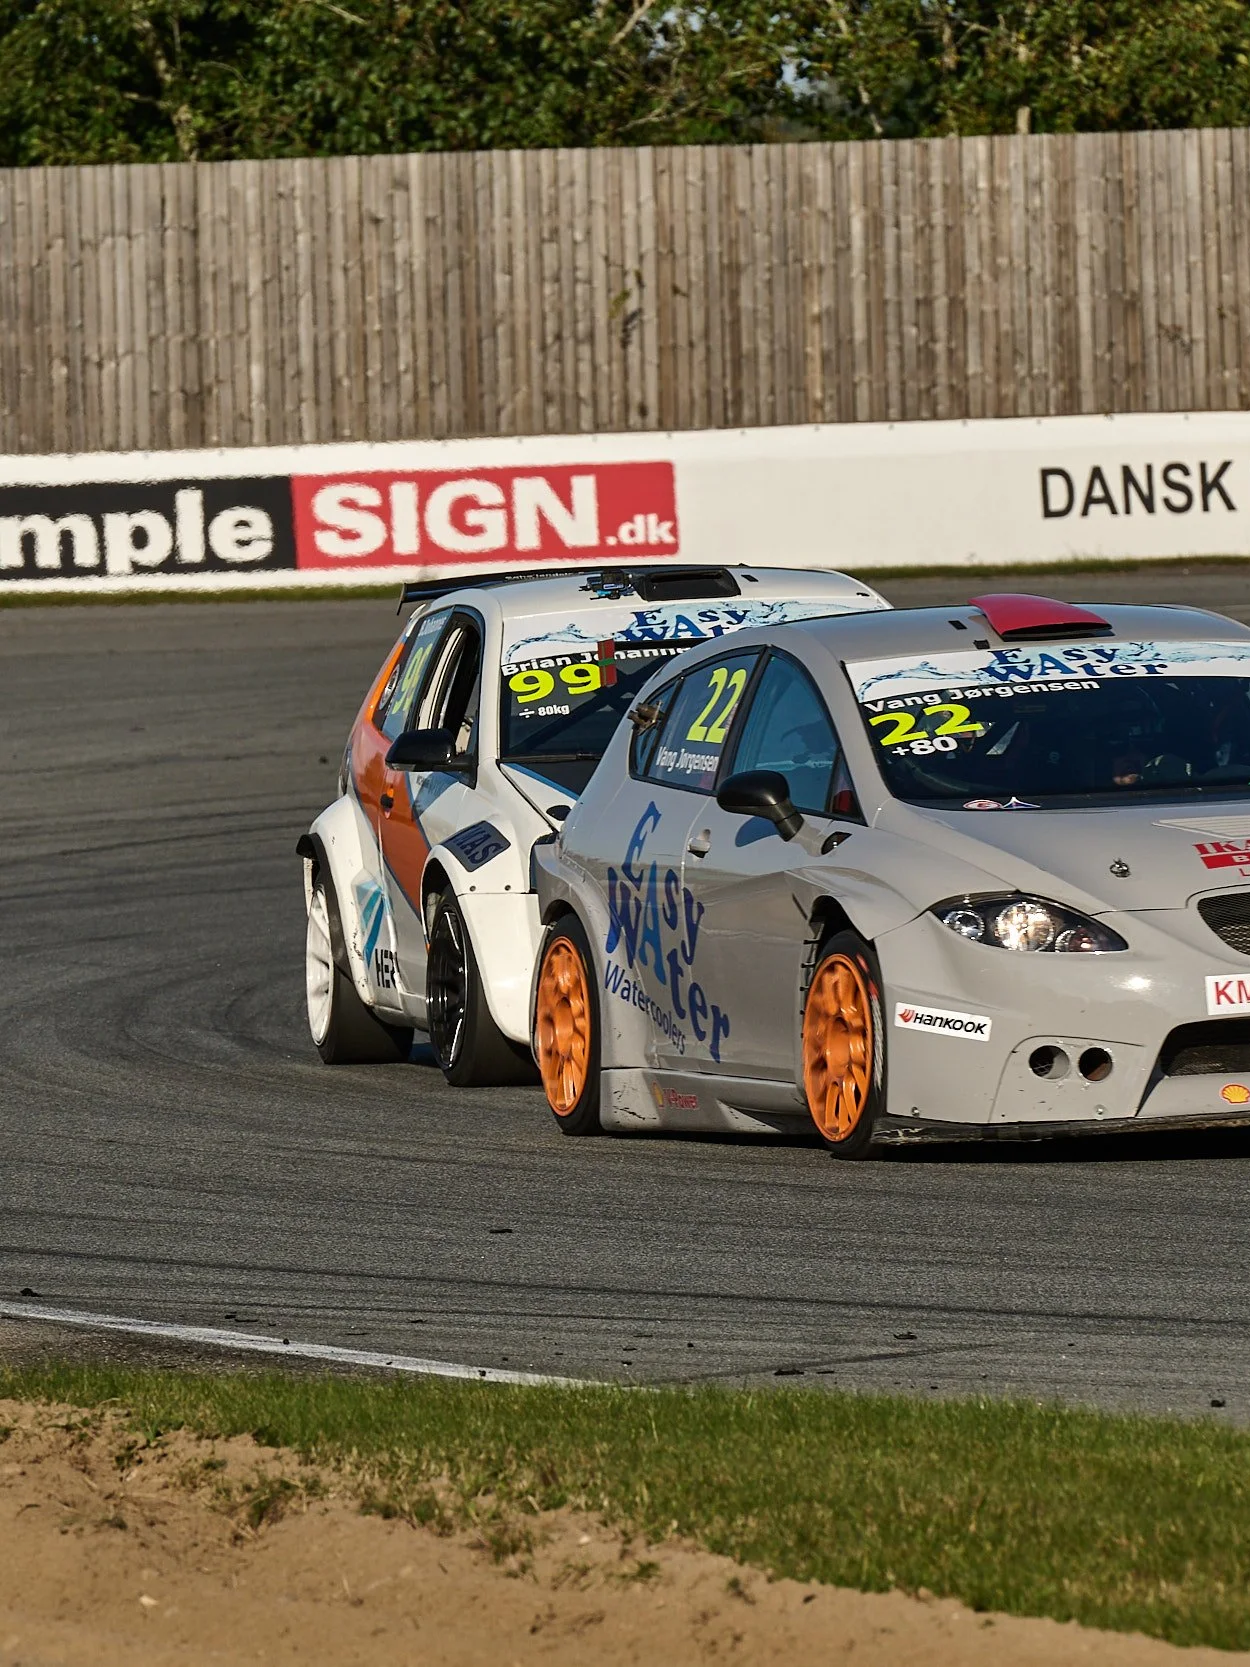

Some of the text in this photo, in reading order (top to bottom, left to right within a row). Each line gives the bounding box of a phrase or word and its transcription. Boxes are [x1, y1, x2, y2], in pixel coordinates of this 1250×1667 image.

[1040, 461, 1236, 518] DANSK
[501, 656, 572, 677] Brian
[509, 663, 601, 703] 99
[538, 704, 570, 716] 80kg
[686, 667, 747, 744] 22
[864, 679, 1101, 713] Vang Jørgensen
[869, 703, 984, 746] 22
[656, 746, 678, 772] Vang
[892, 736, 958, 757] +80
[604, 960, 686, 1055] Watercoolers
